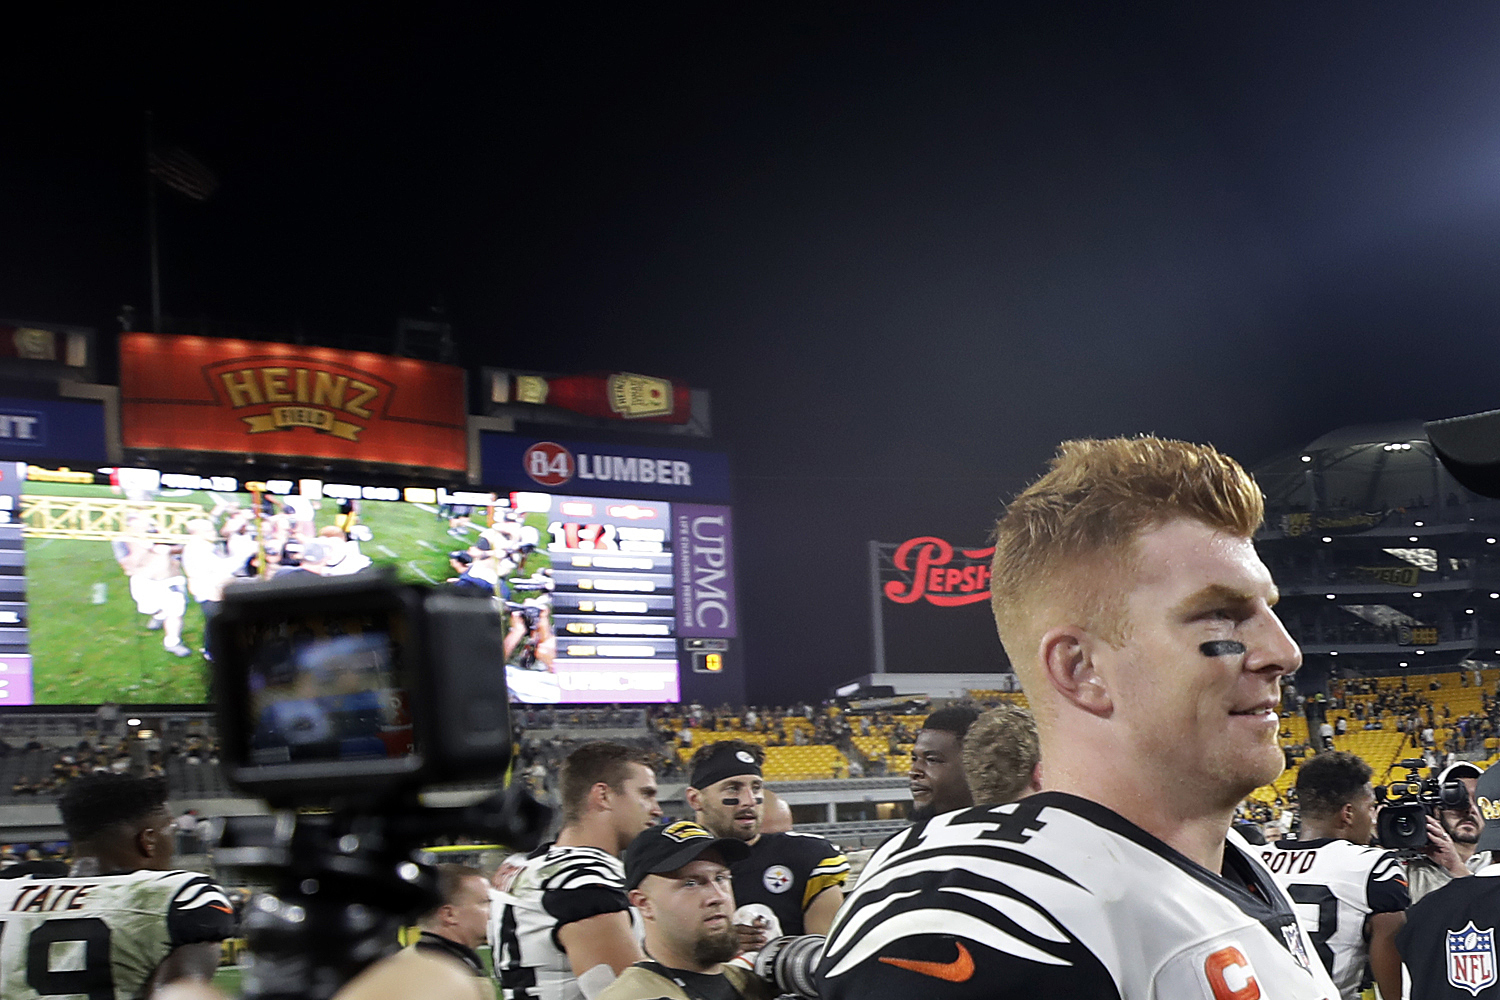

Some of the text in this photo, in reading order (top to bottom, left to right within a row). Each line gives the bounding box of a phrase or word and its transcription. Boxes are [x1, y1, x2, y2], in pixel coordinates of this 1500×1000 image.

[220, 367, 379, 420] HEINZ
[281, 408, 327, 425] FIELD
[530, 450, 692, 486] 84 LUMBER
[691, 515, 729, 628] UPMC
[12, 884, 100, 912] TATE
[1454, 954, 1491, 984] NFL
